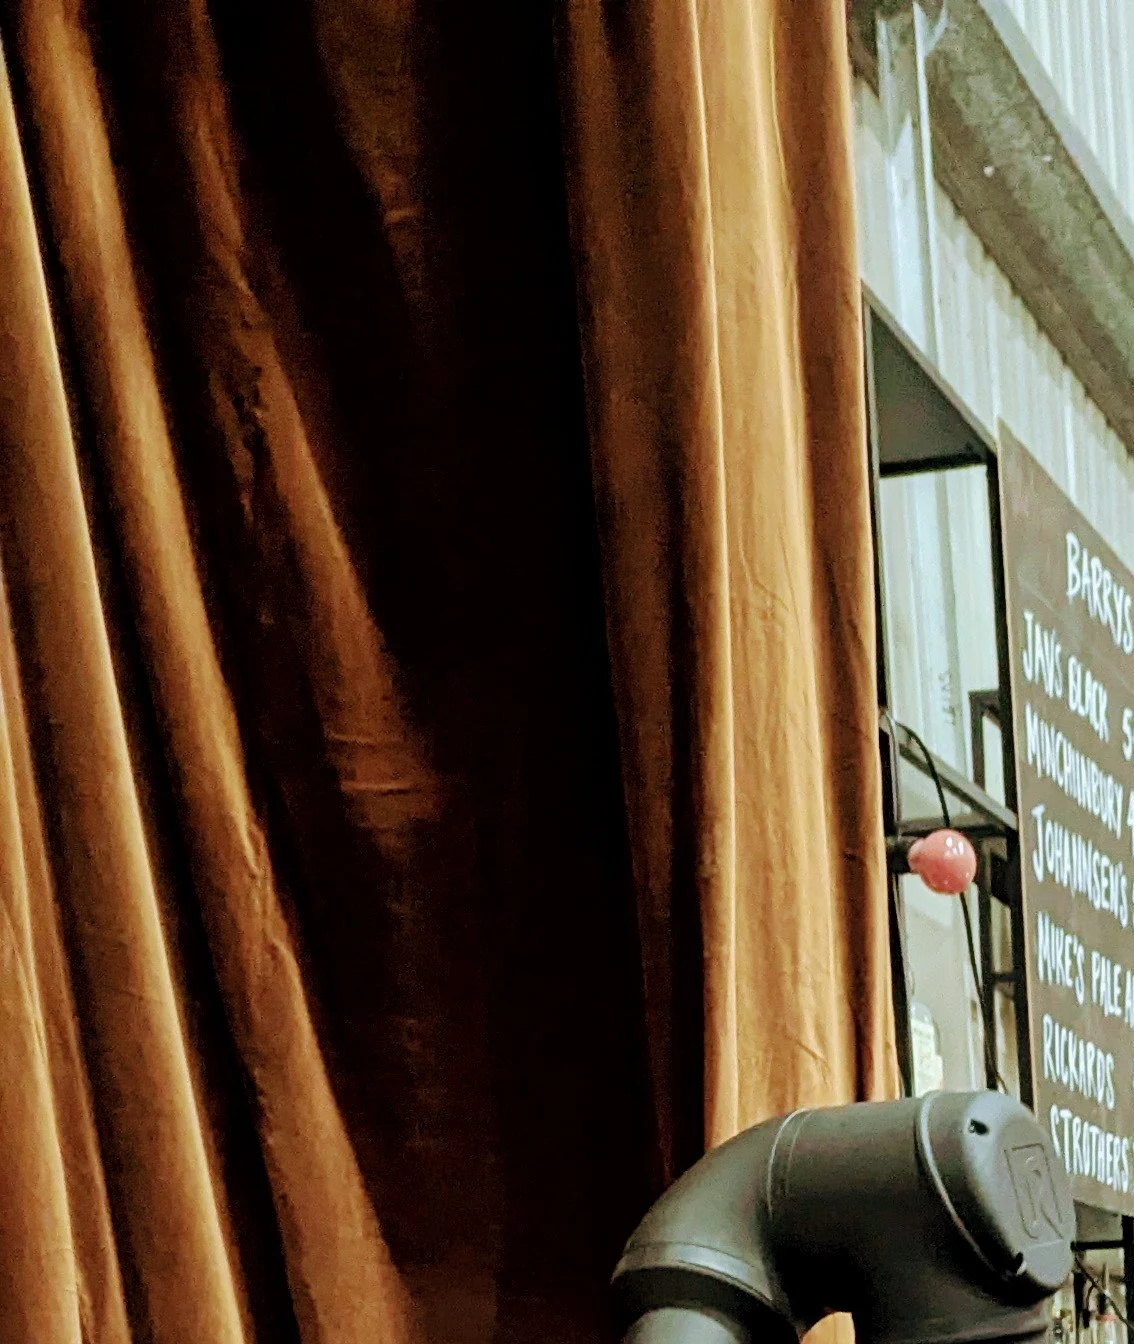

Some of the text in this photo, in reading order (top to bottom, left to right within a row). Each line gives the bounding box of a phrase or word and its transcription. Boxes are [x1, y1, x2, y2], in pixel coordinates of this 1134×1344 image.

[1066, 531, 1134, 655] BARRYS
[1067, 655, 1110, 743] BLACK
[1036, 910, 1085, 1006] MIKE'S
[1091, 950, 1123, 1017] PALE
[1042, 1013, 1115, 1110] RICKARDS
